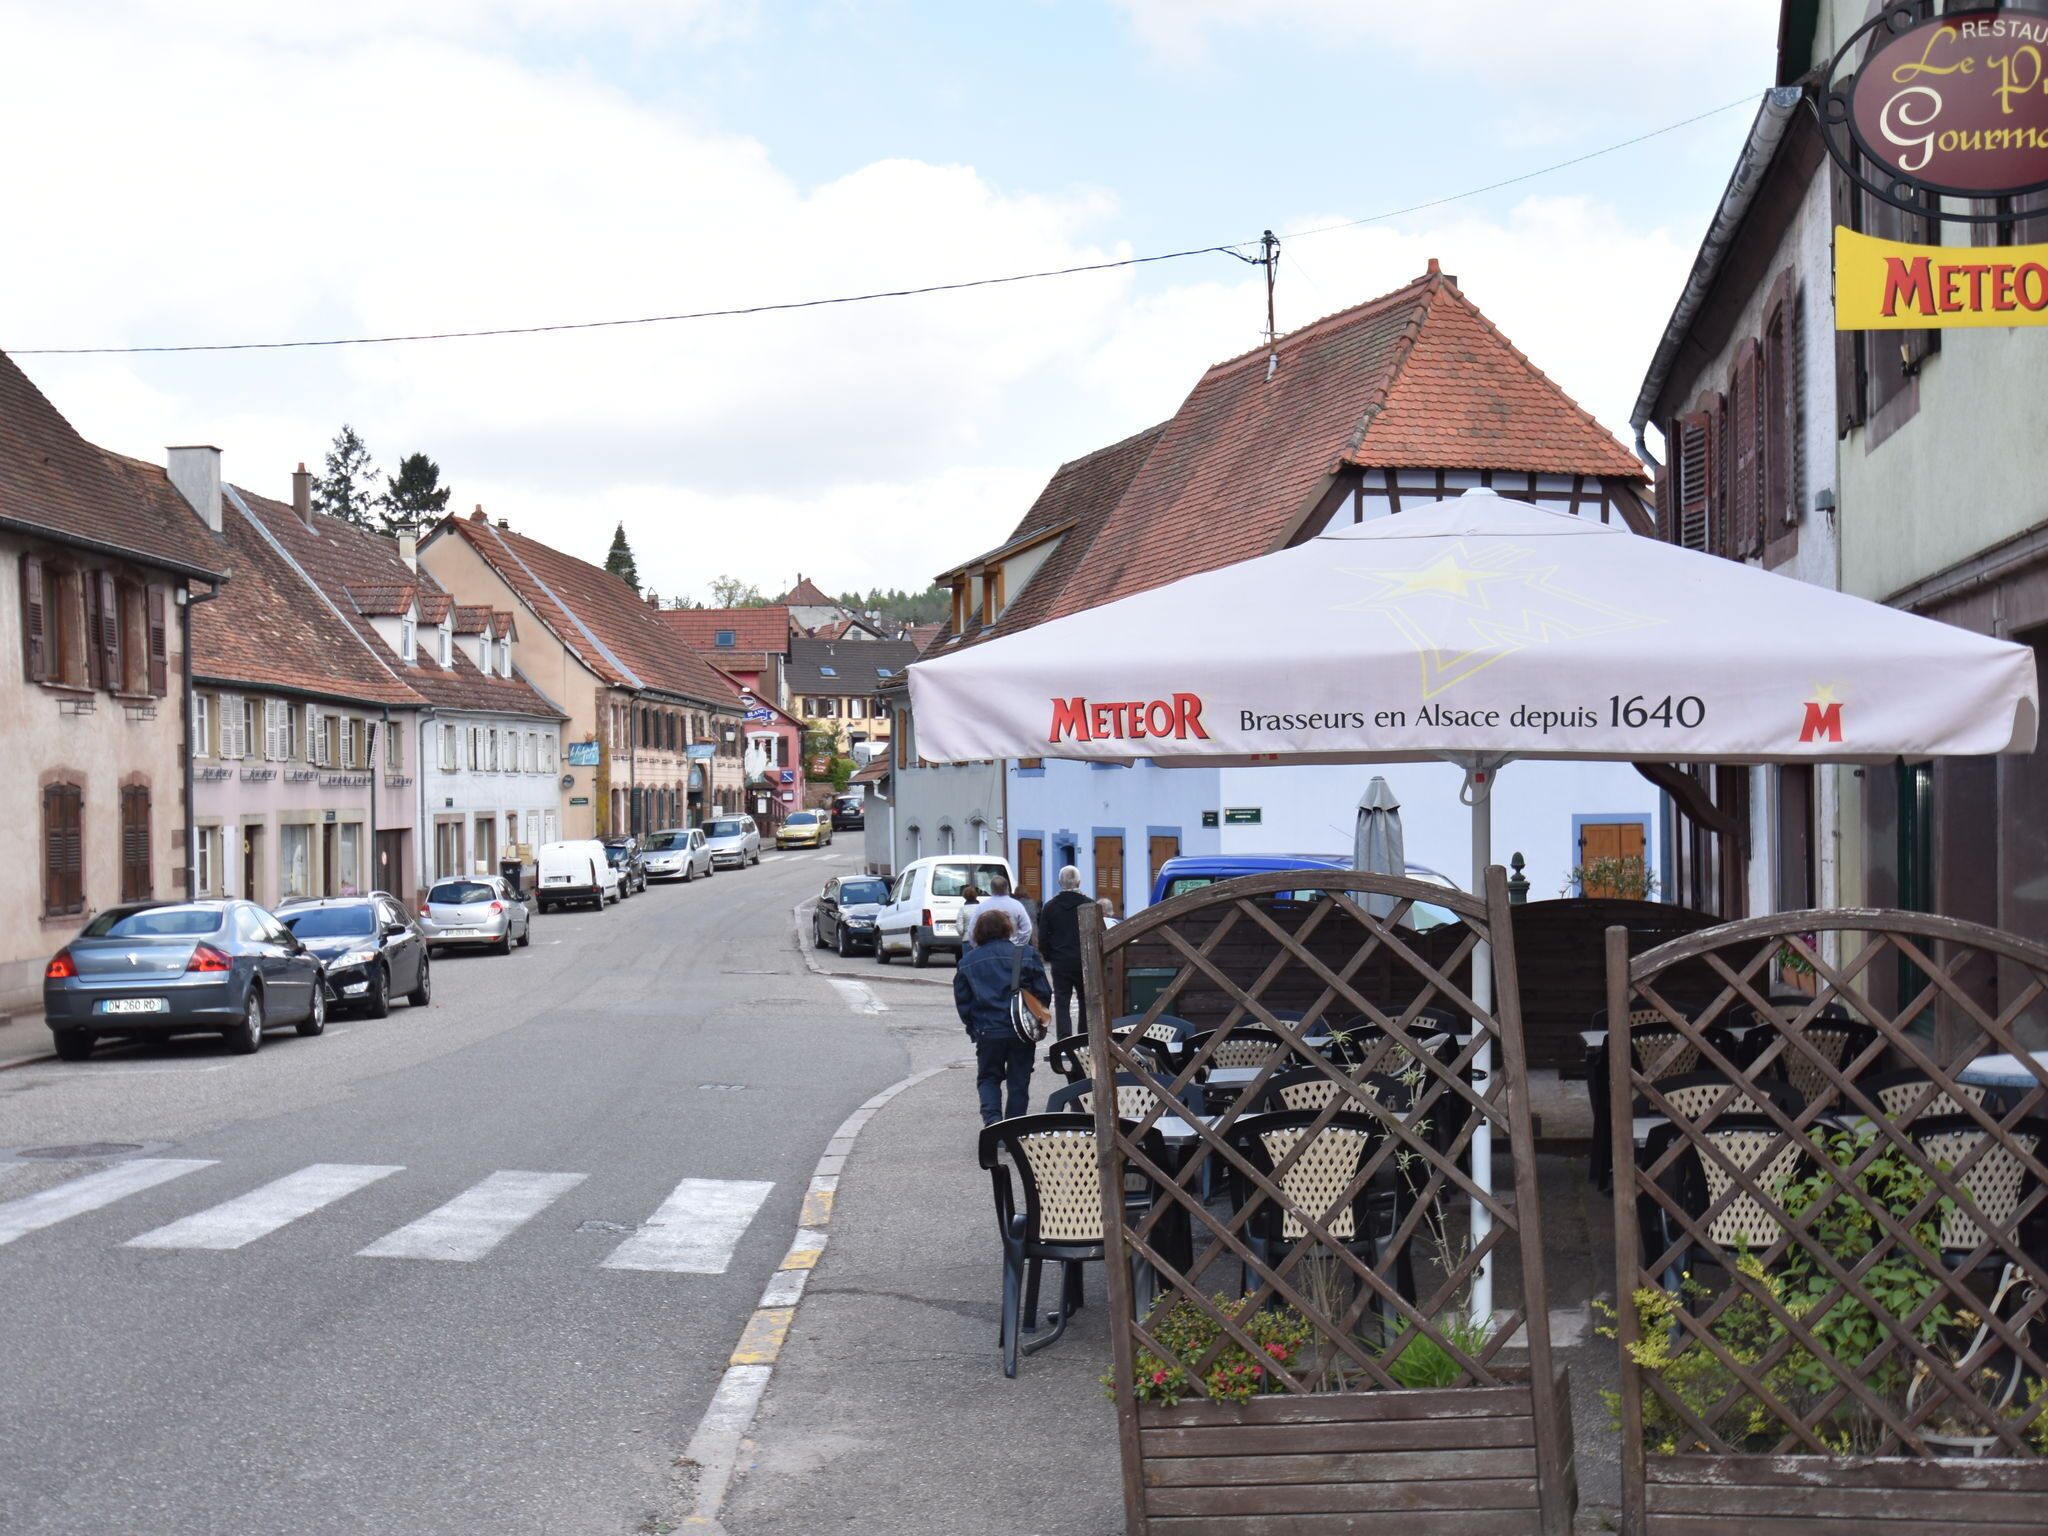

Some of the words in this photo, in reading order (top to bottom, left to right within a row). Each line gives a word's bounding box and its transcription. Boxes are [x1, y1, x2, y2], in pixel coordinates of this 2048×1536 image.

[1892, 26, 1975, 83] Le
[1987, 45, 2048, 114] P
[1880, 256, 2048, 317] METEO
[1049, 692, 1211, 743] METEOR
[1240, 709, 1364, 732] Brasseurs
[1374, 711, 1406, 728] en
[1415, 703, 1499, 728] Alsace
[1510, 705, 1598, 734] depuis
[1609, 695, 1706, 729] 1640
[1799, 702, 1843, 742] M
